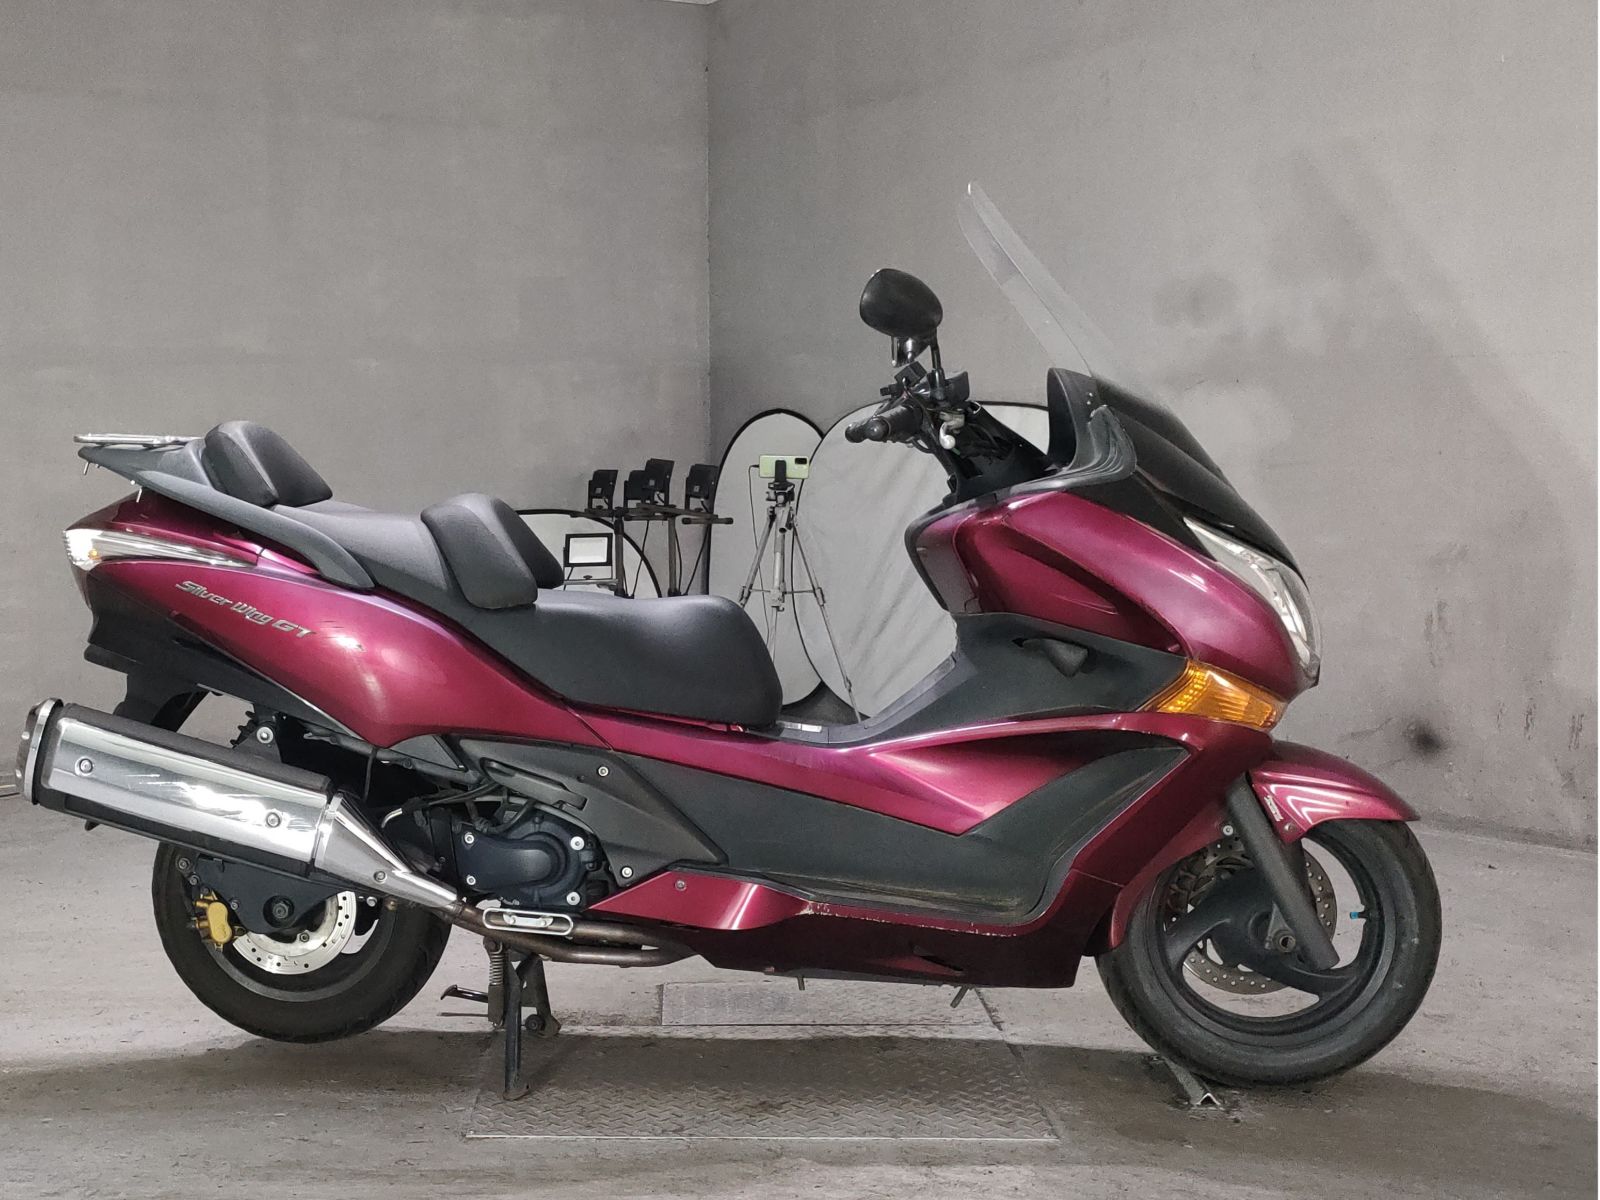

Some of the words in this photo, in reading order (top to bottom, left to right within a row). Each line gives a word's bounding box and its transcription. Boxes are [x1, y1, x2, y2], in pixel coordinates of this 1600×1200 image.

[175, 580, 233, 606] Silver
[230, 601, 274, 625] Wing
[272, 619, 315, 638] GT
